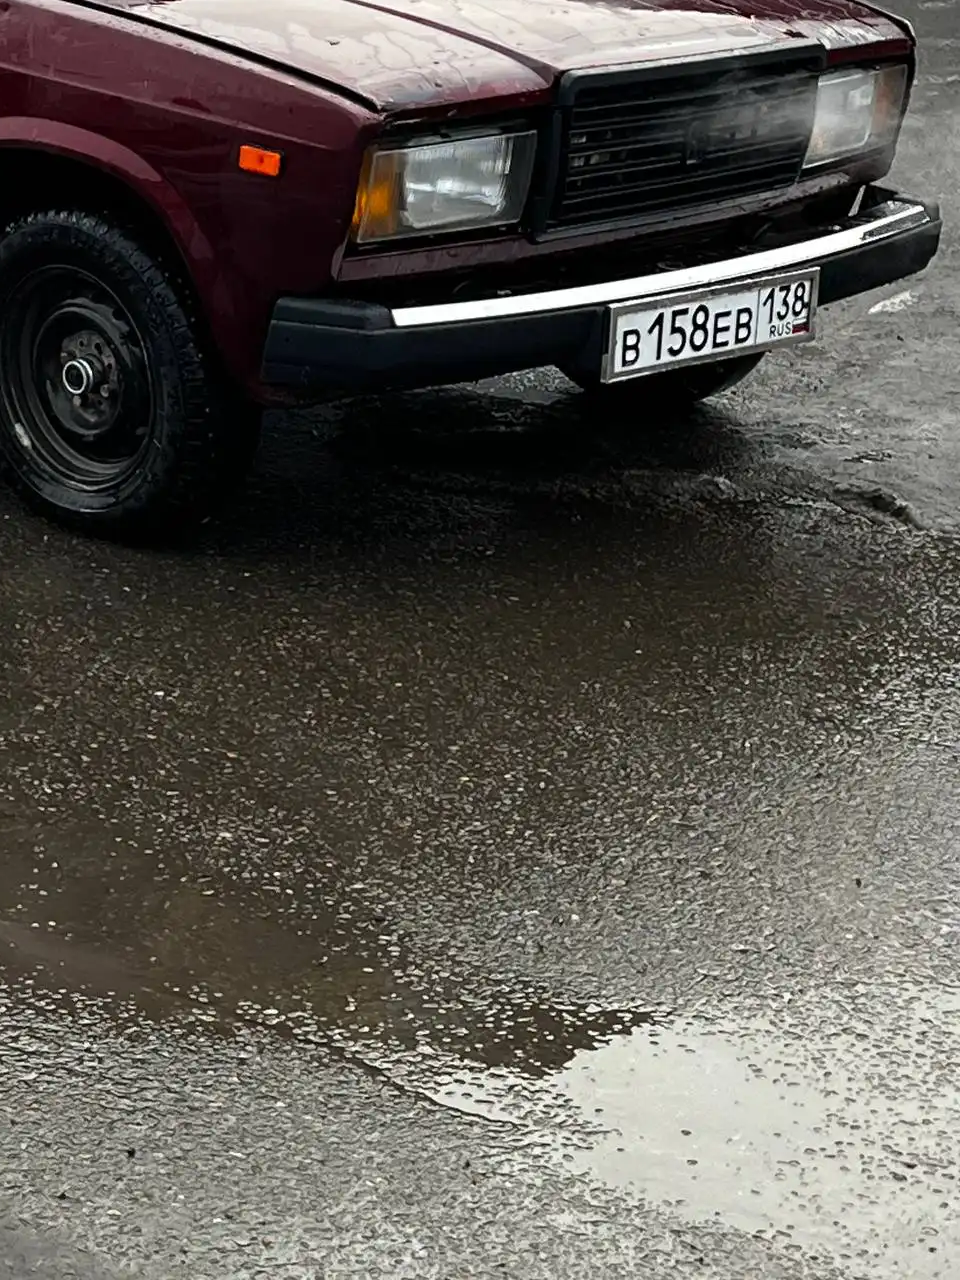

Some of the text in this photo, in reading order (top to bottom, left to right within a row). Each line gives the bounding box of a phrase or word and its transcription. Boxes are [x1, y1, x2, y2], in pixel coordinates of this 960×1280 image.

[621, 281, 808, 368] В158ЕВ 138
[768, 321, 792, 339] RUS
